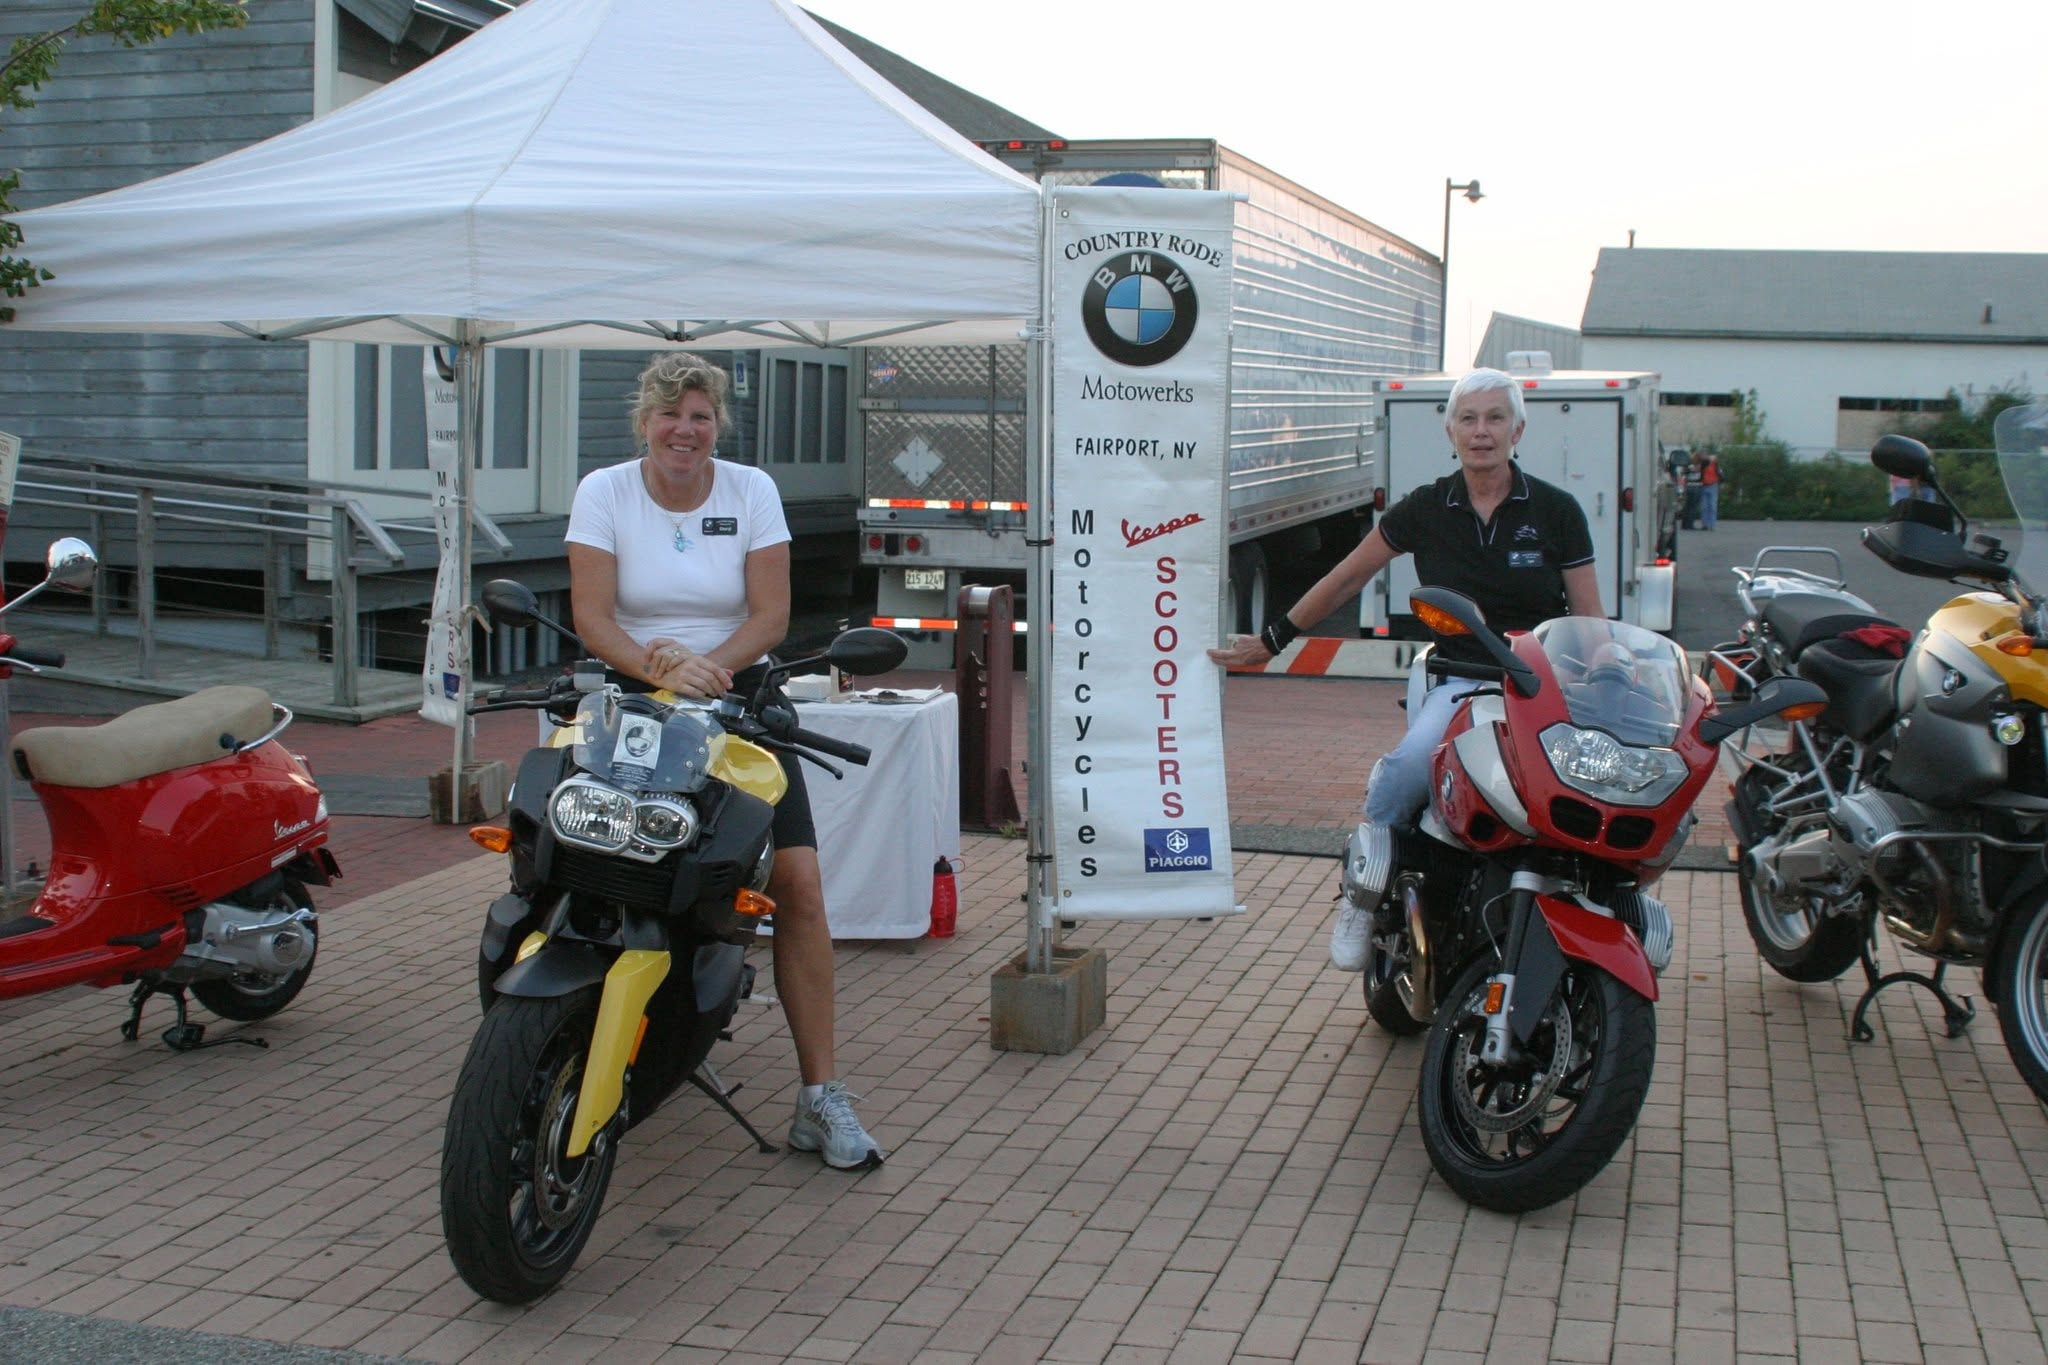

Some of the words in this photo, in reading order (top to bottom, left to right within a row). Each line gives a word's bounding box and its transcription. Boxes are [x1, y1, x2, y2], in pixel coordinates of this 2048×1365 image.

[1064, 231, 1164, 260] COUNTRY
[1168, 234, 1224, 269] RODE
[1094, 254, 1190, 294] BMW
[1081, 374, 1194, 404] Motowerks
[1075, 437, 1165, 460] FAIRPORT,
[1173, 441, 1197, 459] NY
[1121, 512, 1206, 548] Vespa
[1071, 509, 1098, 877] Motorcycles
[1153, 556, 1185, 819] SCOOTERS
[1149, 854, 1209, 868] PIAGGIO
